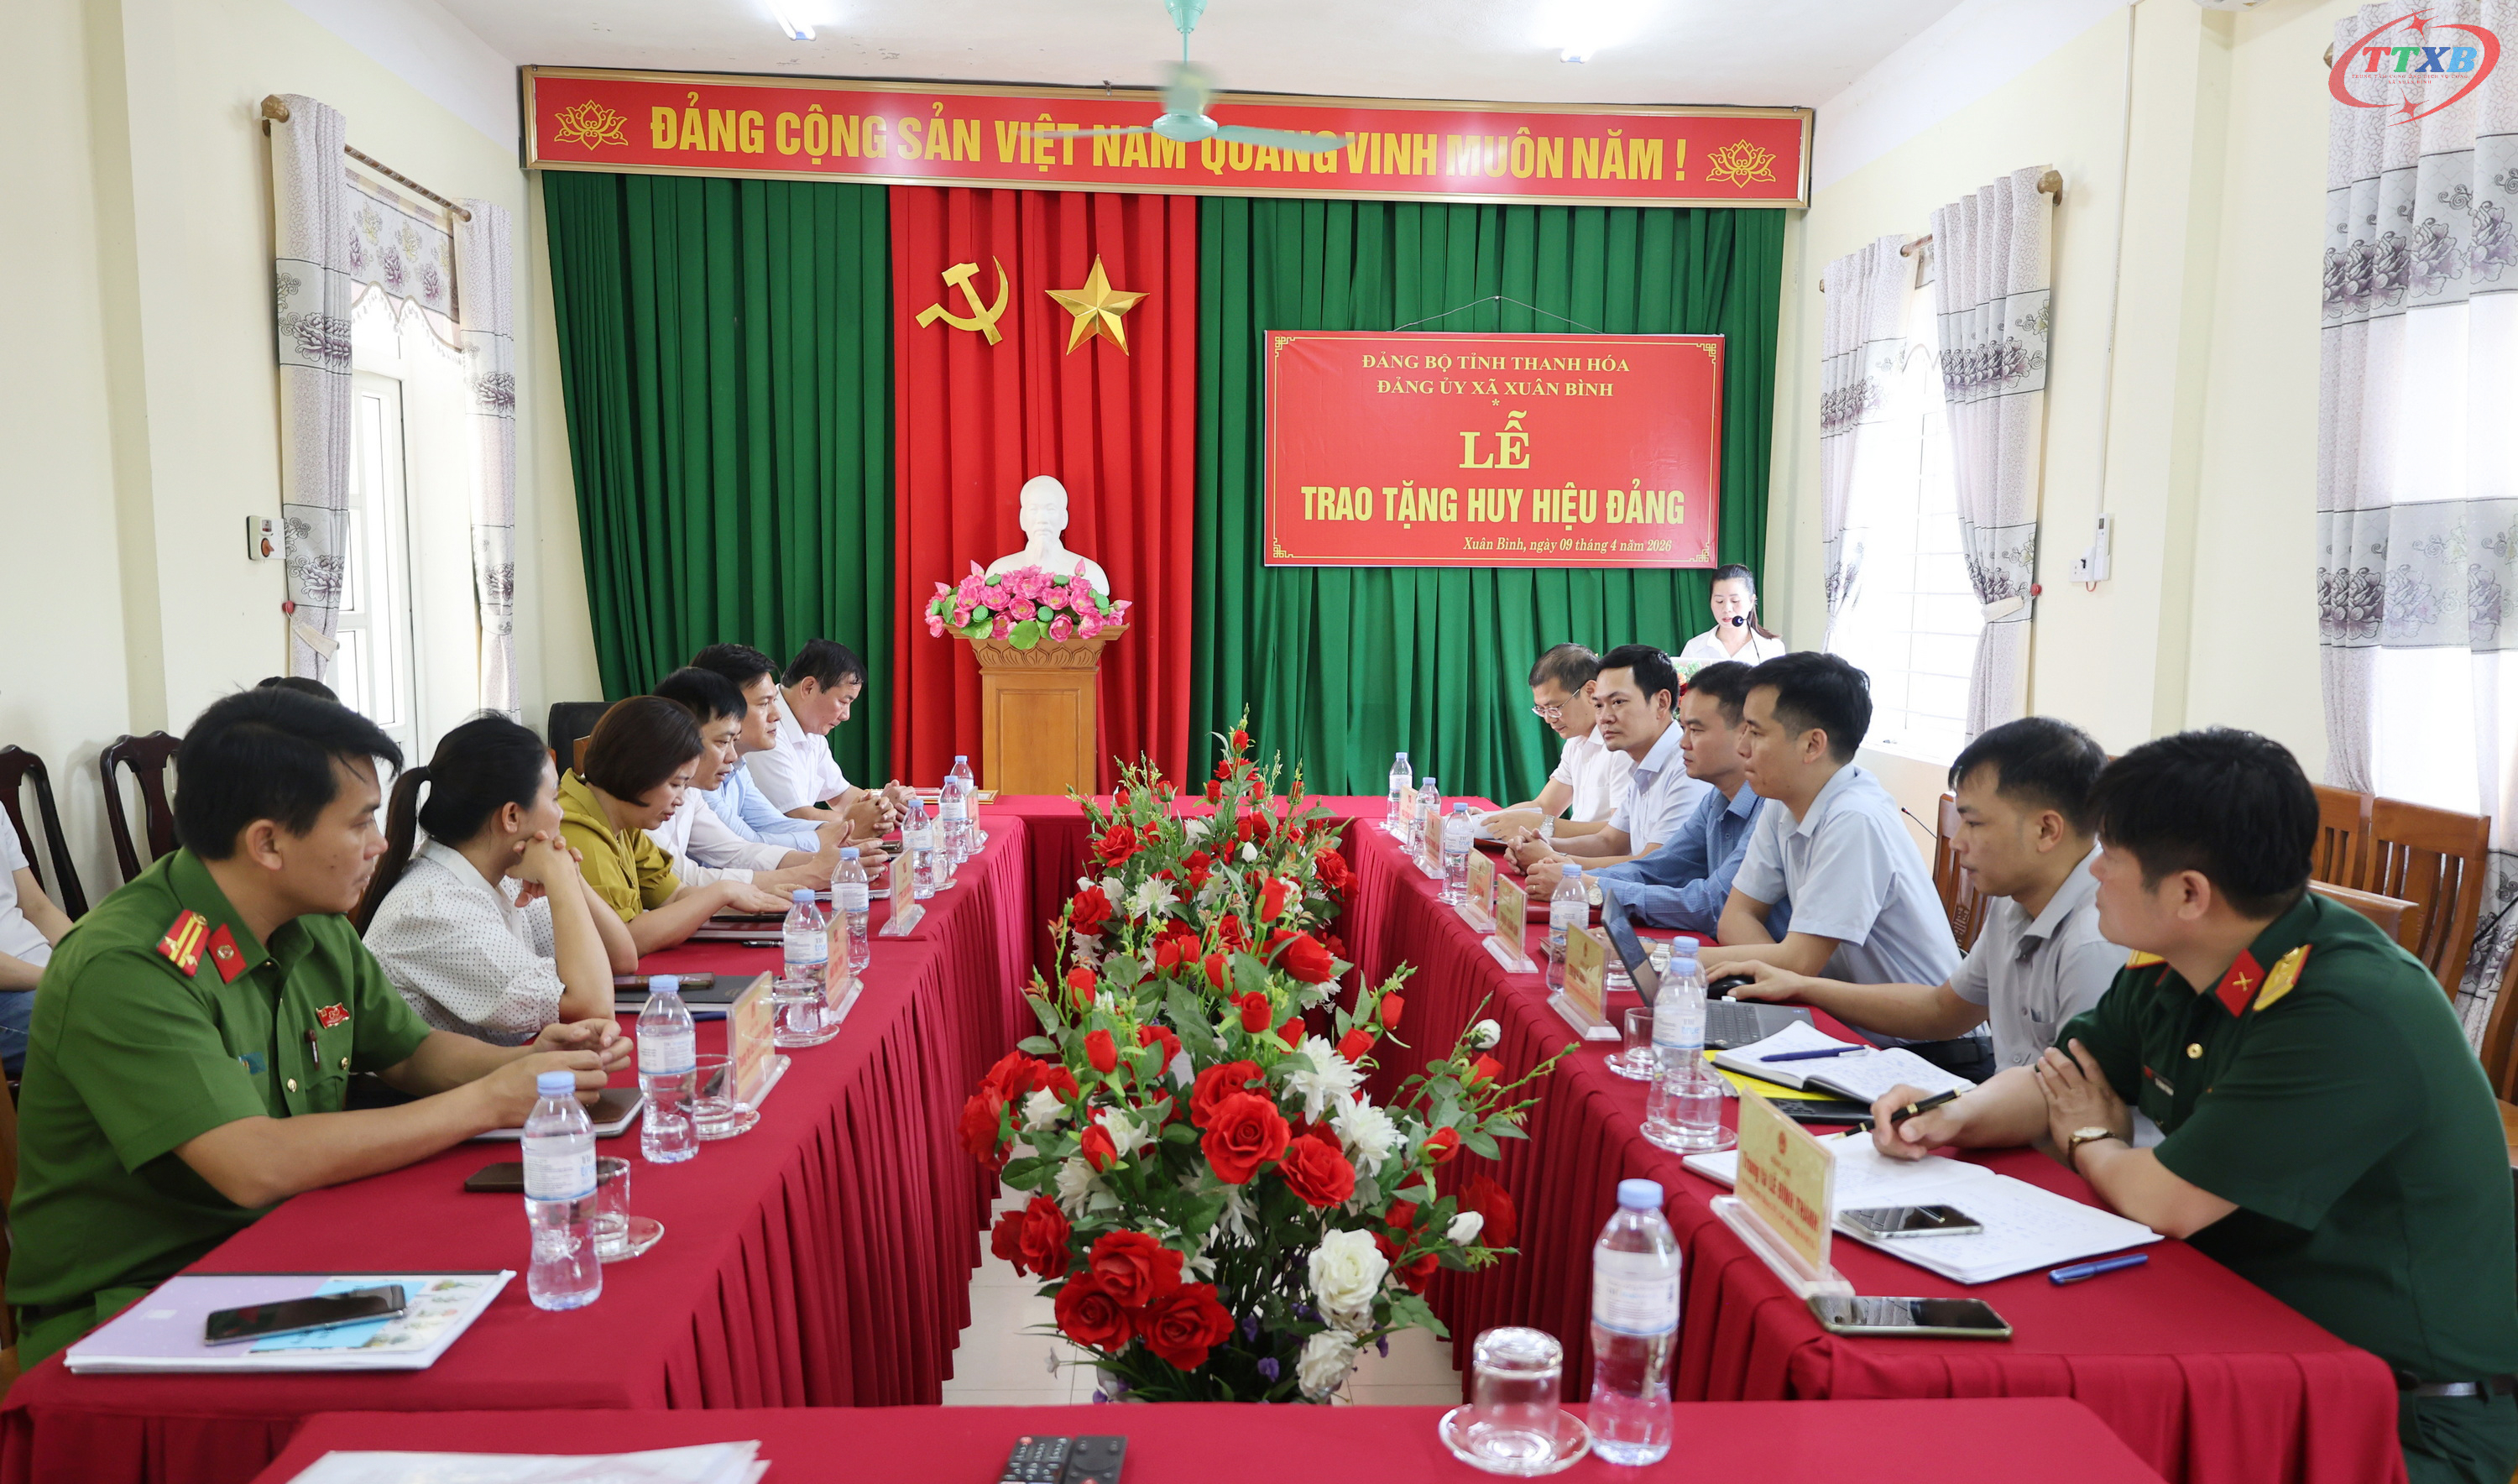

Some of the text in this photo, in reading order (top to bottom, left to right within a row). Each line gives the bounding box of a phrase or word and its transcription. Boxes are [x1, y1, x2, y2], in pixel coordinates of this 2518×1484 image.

[650, 92, 764, 154] ĐẢNG
[776, 103, 886, 165] CỘNG
[897, 102, 981, 162] SẢN
[996, 112, 1079, 173] VIỆT
[1092, 124, 1187, 170] NAM
[1200, 128, 1338, 175] QUANG
[1345, 131, 1438, 175] VINH
[1445, 126, 1565, 179] MUÔN
[1571, 128, 1664, 181] NĂM
[1361, 351, 1631, 373] ĐẢNG BỘ TỈNH THANH HÓA
[1377, 376, 1614, 397] ĐẢNG ỦY XÃ XUÂN BÌNH
[1458, 410, 1531, 470] LỄ
[1300, 478, 1685, 531] TRAO TẶNG HUY HIỆU ĐẢNG
[1463, 536, 1673, 555] Xuân Bình, ngày 09 tháng 4 năm 2026
